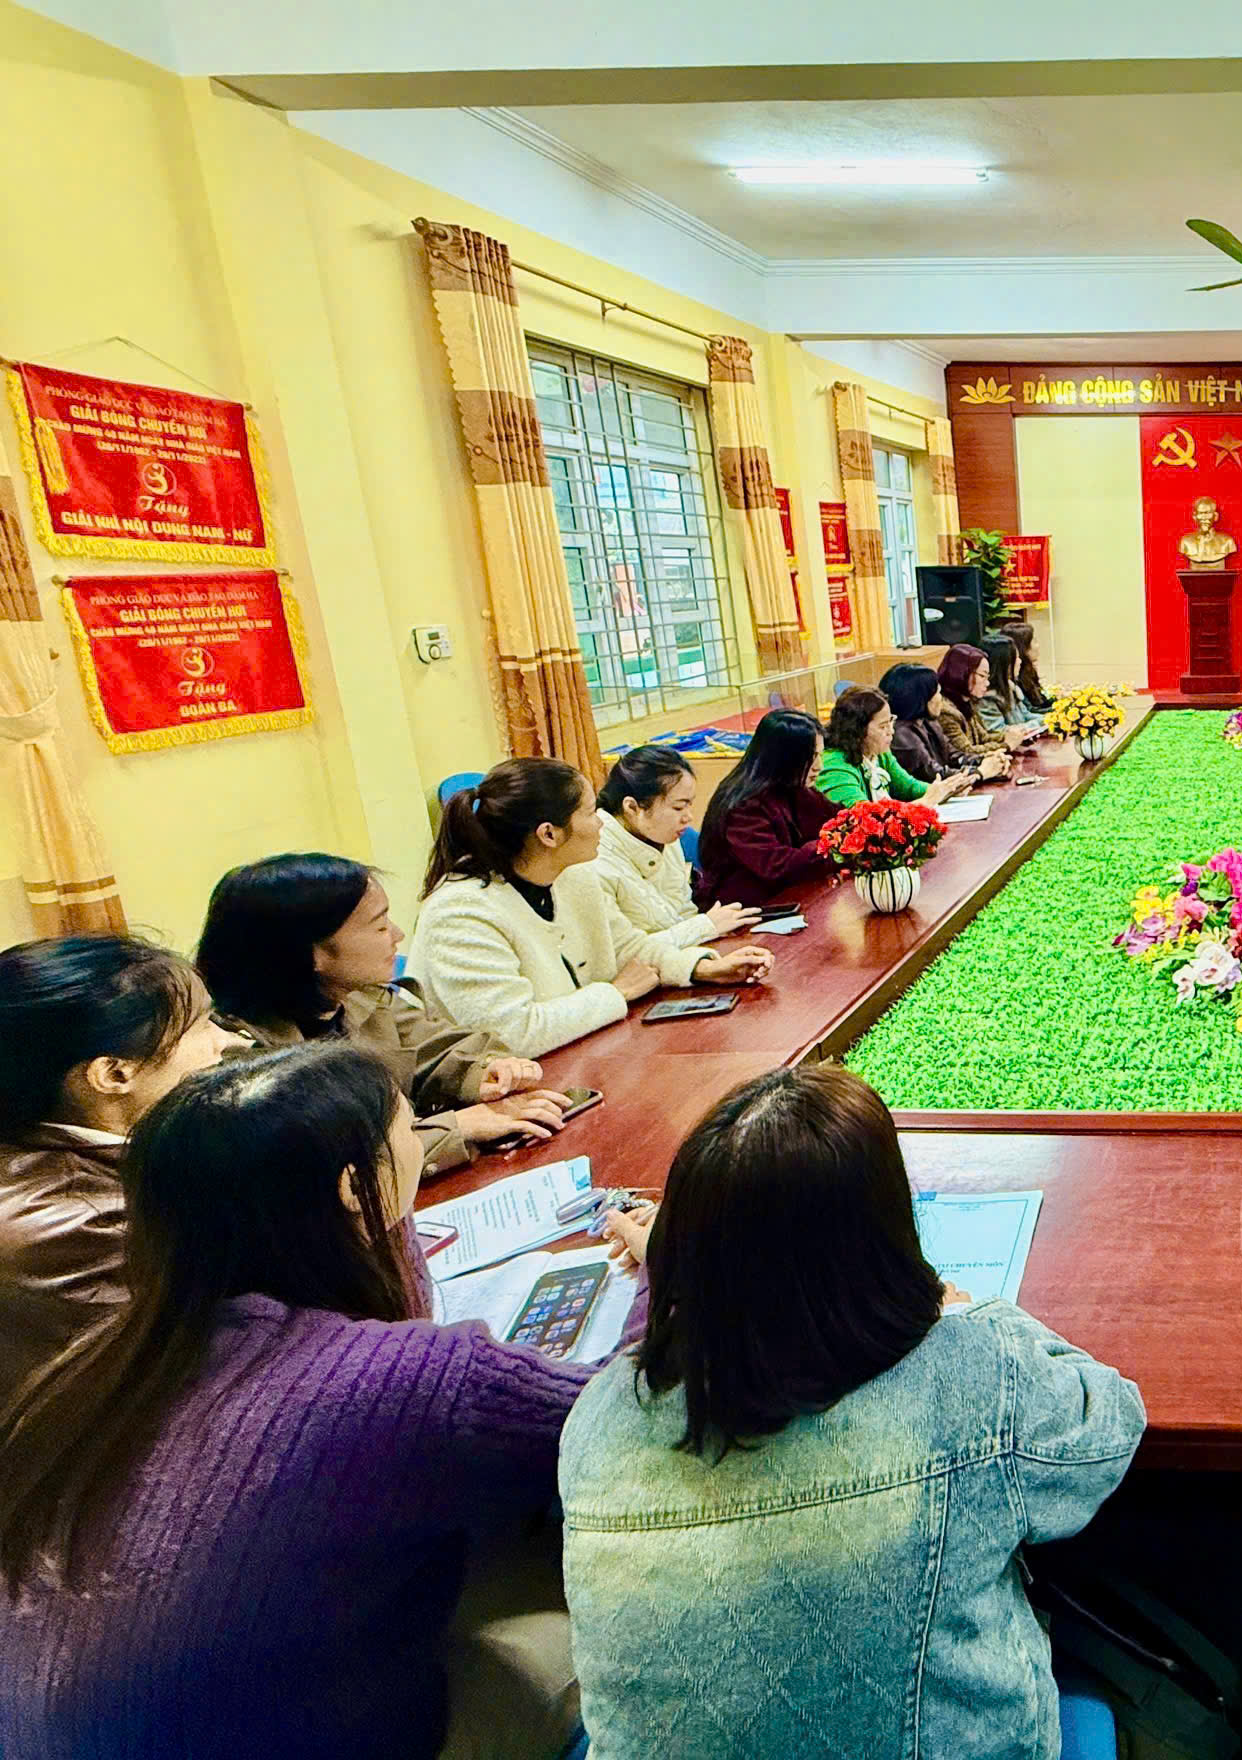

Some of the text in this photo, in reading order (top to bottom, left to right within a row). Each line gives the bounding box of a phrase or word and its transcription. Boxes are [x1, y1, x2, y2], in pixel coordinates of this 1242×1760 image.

[1022, 373, 1077, 405] ĐẢNG
[1081, 375, 1135, 407] CỘNG
[1139, 373, 1180, 404] SẢN
[1187, 375, 1227, 406] VIỆT
[151, 521, 191, 537] DUNG
[191, 524, 225, 540] NAM
